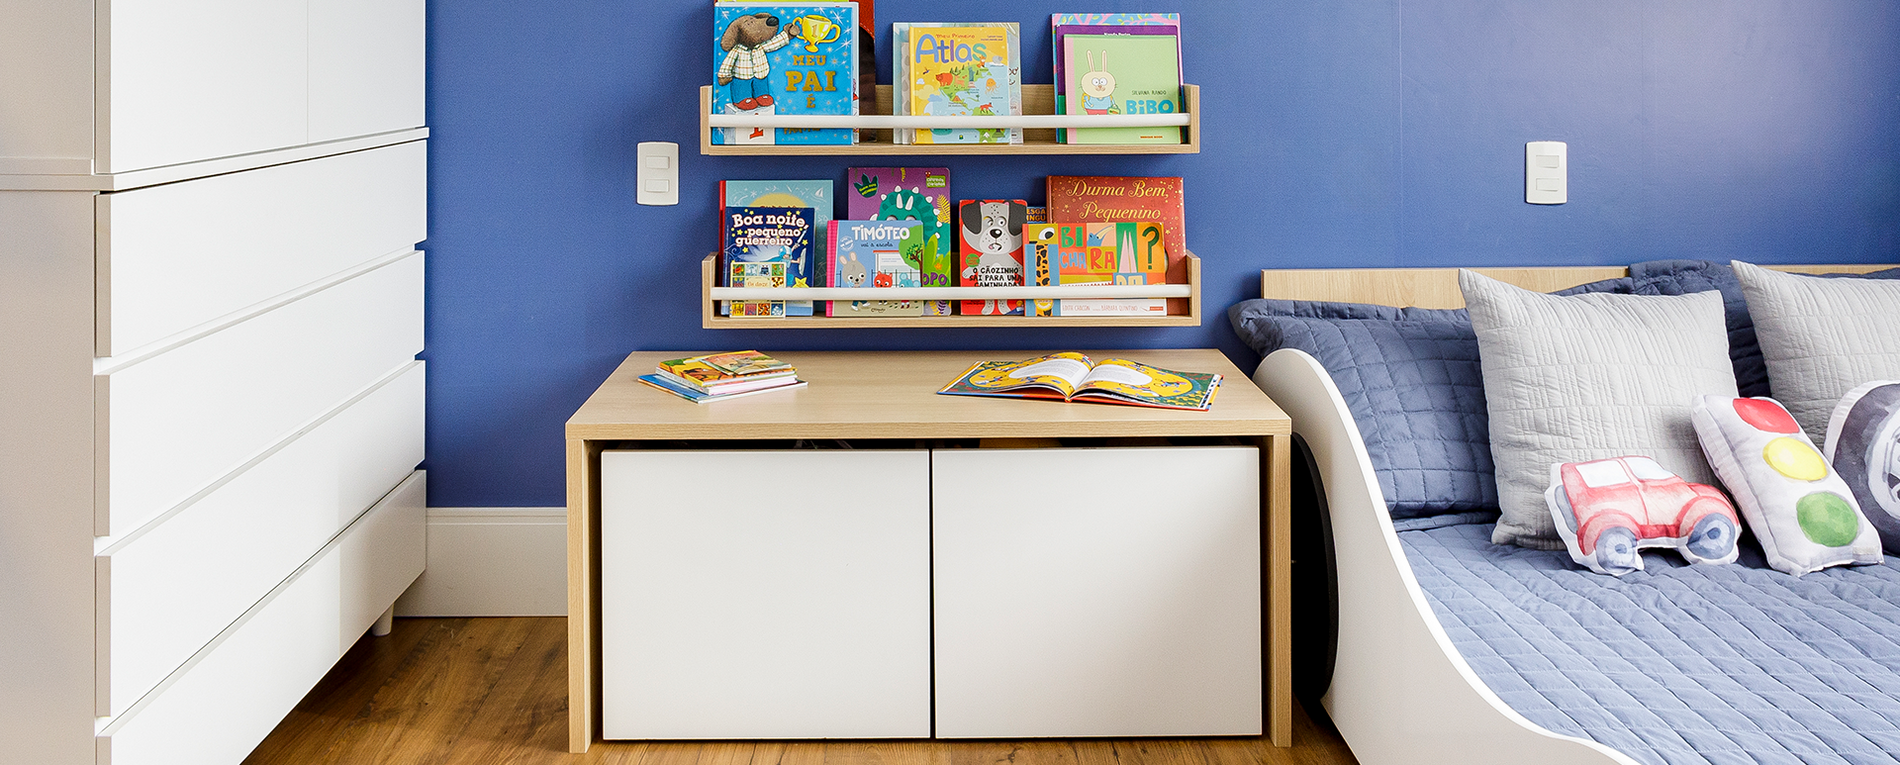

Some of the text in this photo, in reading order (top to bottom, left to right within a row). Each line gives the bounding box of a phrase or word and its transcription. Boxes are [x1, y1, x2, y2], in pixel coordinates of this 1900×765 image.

[915, 33, 987, 64] Atlas
[792, 55, 827, 66] MEU
[785, 71, 836, 92] PAI
[806, 93, 816, 108] É
[1066, 179, 1170, 198] Durma Bem,
[1079, 201, 1162, 223] Pequenino
[731, 214, 810, 229] Boa noite,
[735, 236, 793, 247] guerreiro
[747, 227, 802, 238] pequeno
[1061, 226, 1083, 248] BI
[1059, 251, 1087, 269] CHA
[1091, 248, 1116, 269] RA
[980, 265, 1019, 274] CÃOZINHO
